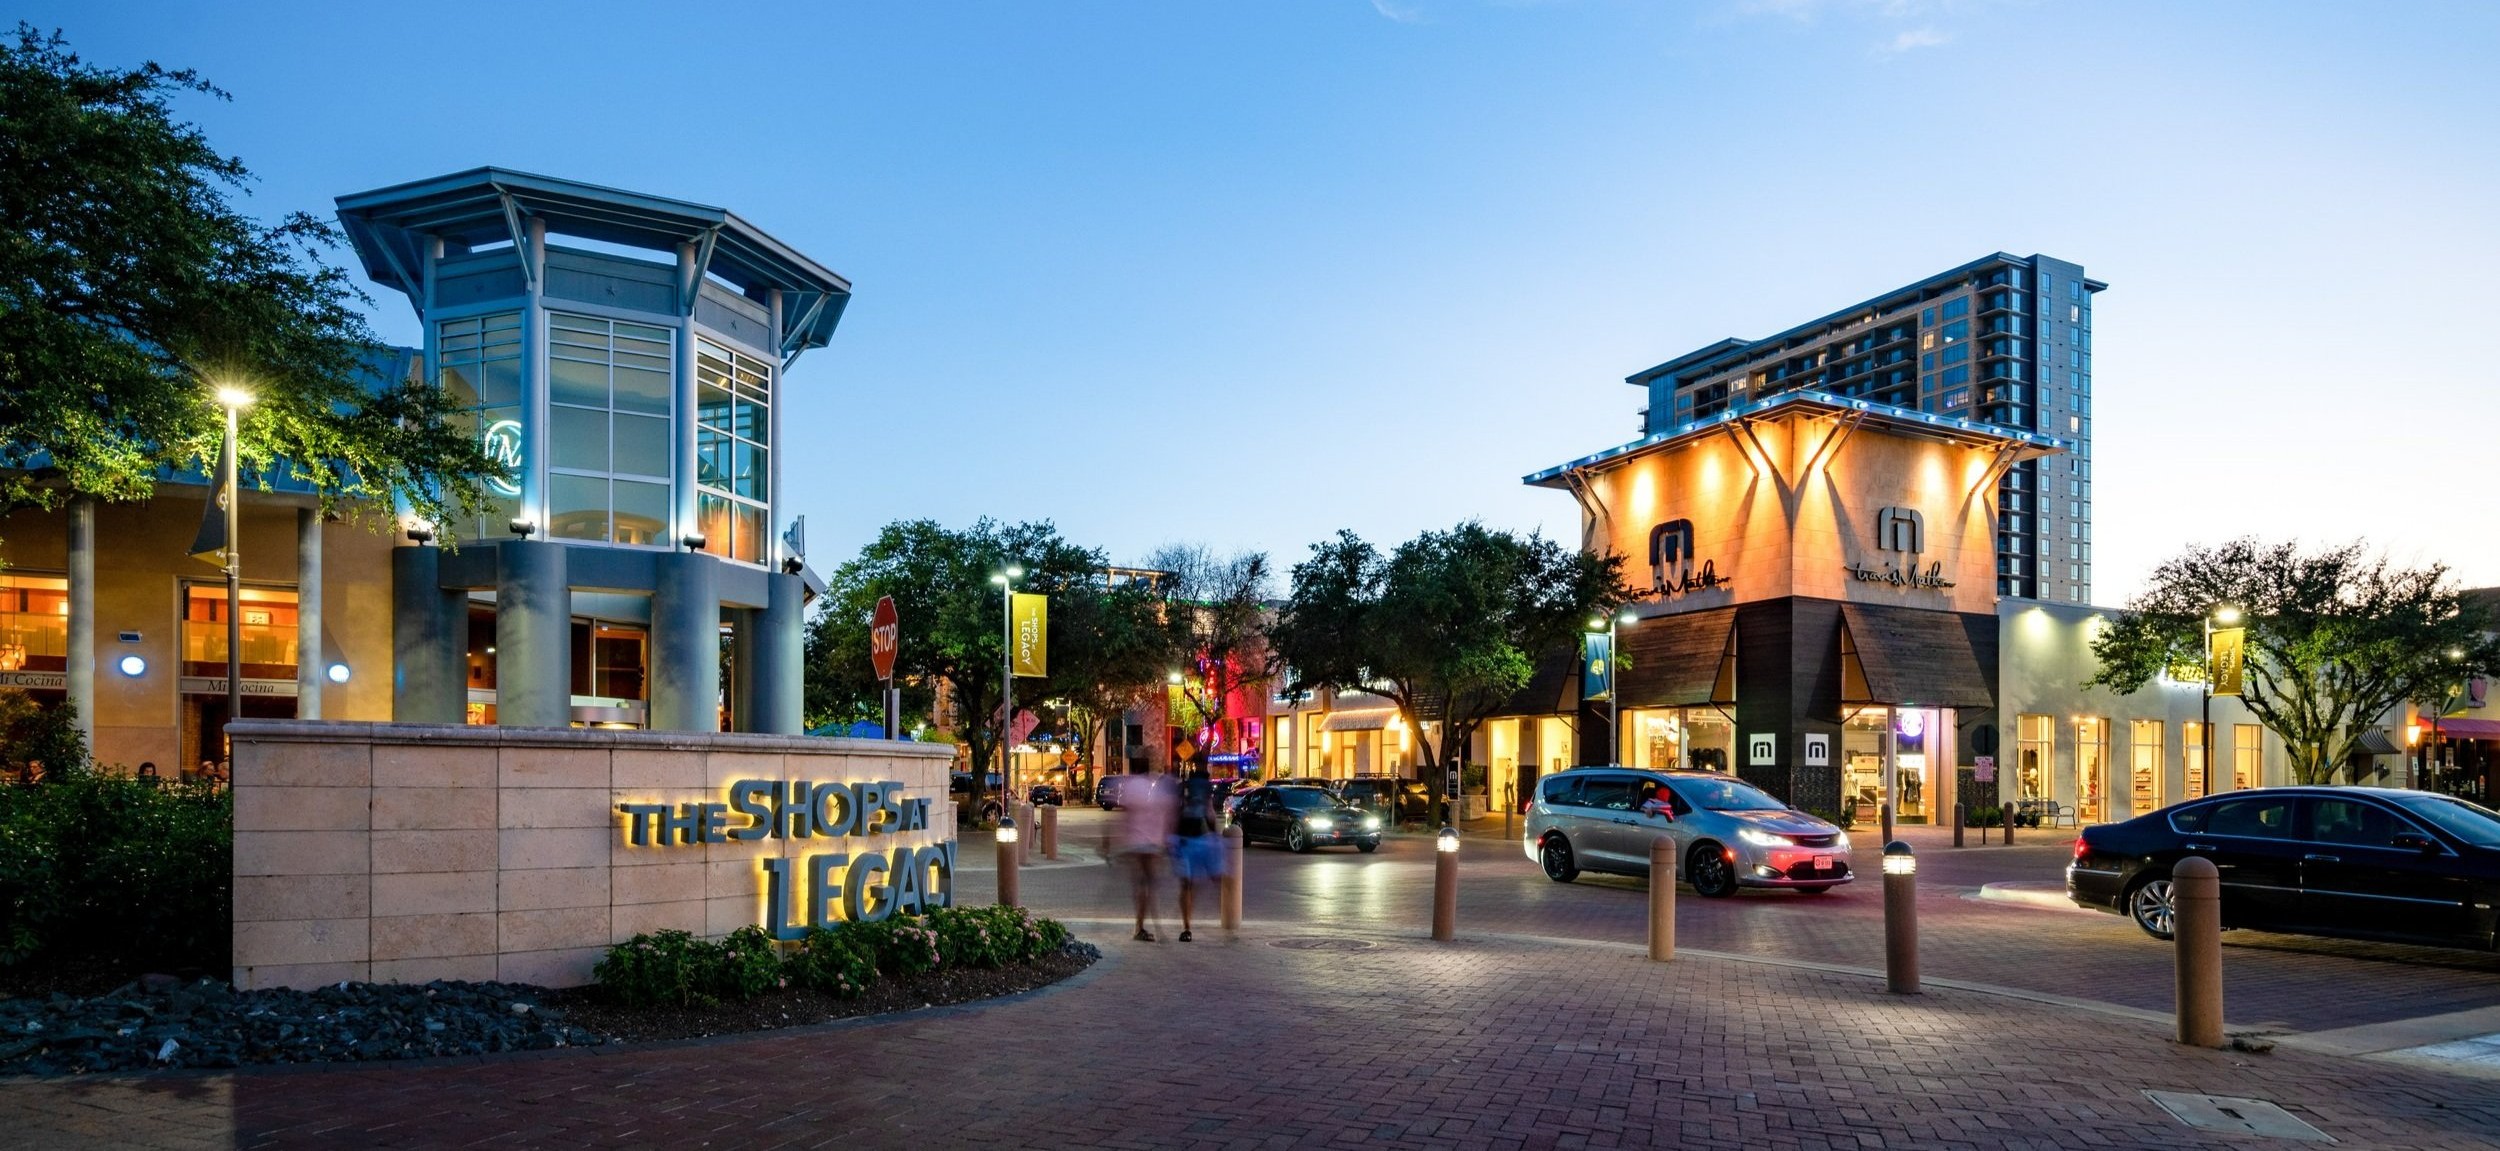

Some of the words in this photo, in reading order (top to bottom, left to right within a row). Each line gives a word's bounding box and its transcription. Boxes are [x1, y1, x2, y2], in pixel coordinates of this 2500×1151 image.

[873, 624, 896, 655] STOP
[1021, 620, 1031, 665] LEGACY
[0, 672, 9, 685] i
[14, 673, 63, 686] Cocina
[207, 679, 226, 692] Mi
[240, 681, 275, 693] ocina
[2220, 650, 2229, 687] LEGACY
[621, 802, 728, 846] THE
[727, 779, 905, 840] SHOPS
[901, 796, 932, 832] AT
[762, 840, 959, 941] LEGACY
